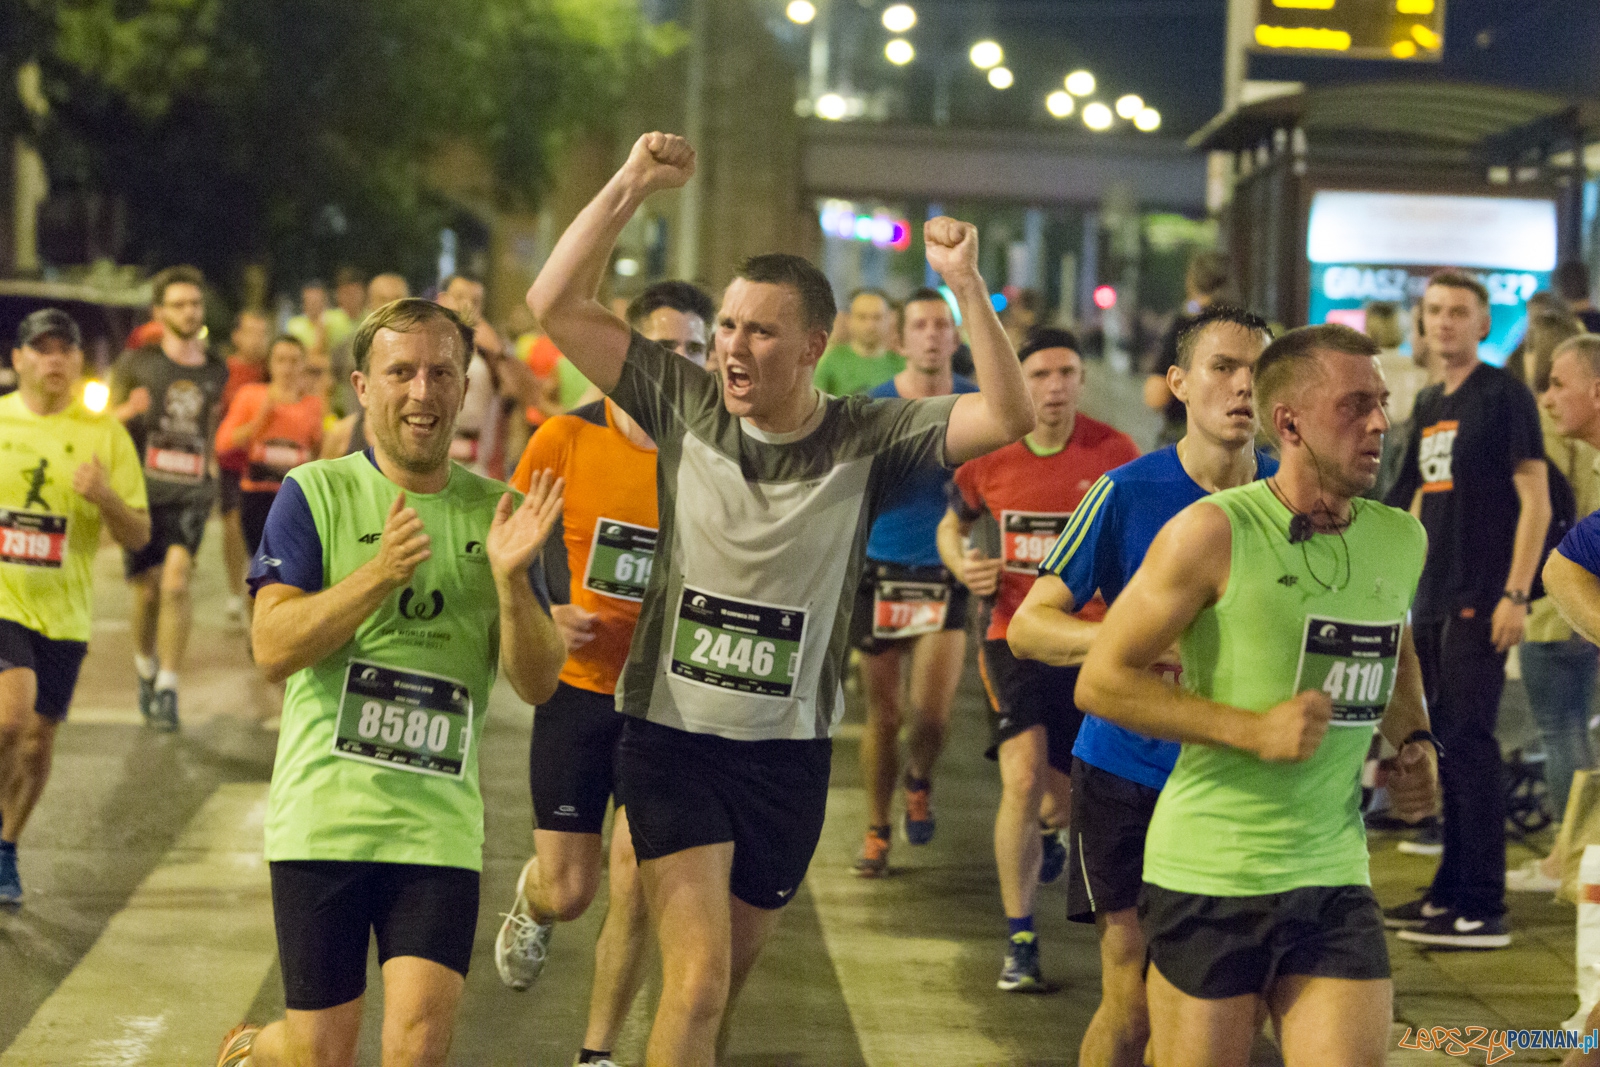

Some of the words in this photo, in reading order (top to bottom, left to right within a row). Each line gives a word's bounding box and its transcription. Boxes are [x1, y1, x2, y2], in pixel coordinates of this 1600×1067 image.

[2, 529, 51, 558] 7319
[358, 532, 382, 544] 4F
[690, 627, 776, 677] 2446
[1322, 660, 1384, 701] 4110
[358, 701, 450, 753] 8580
